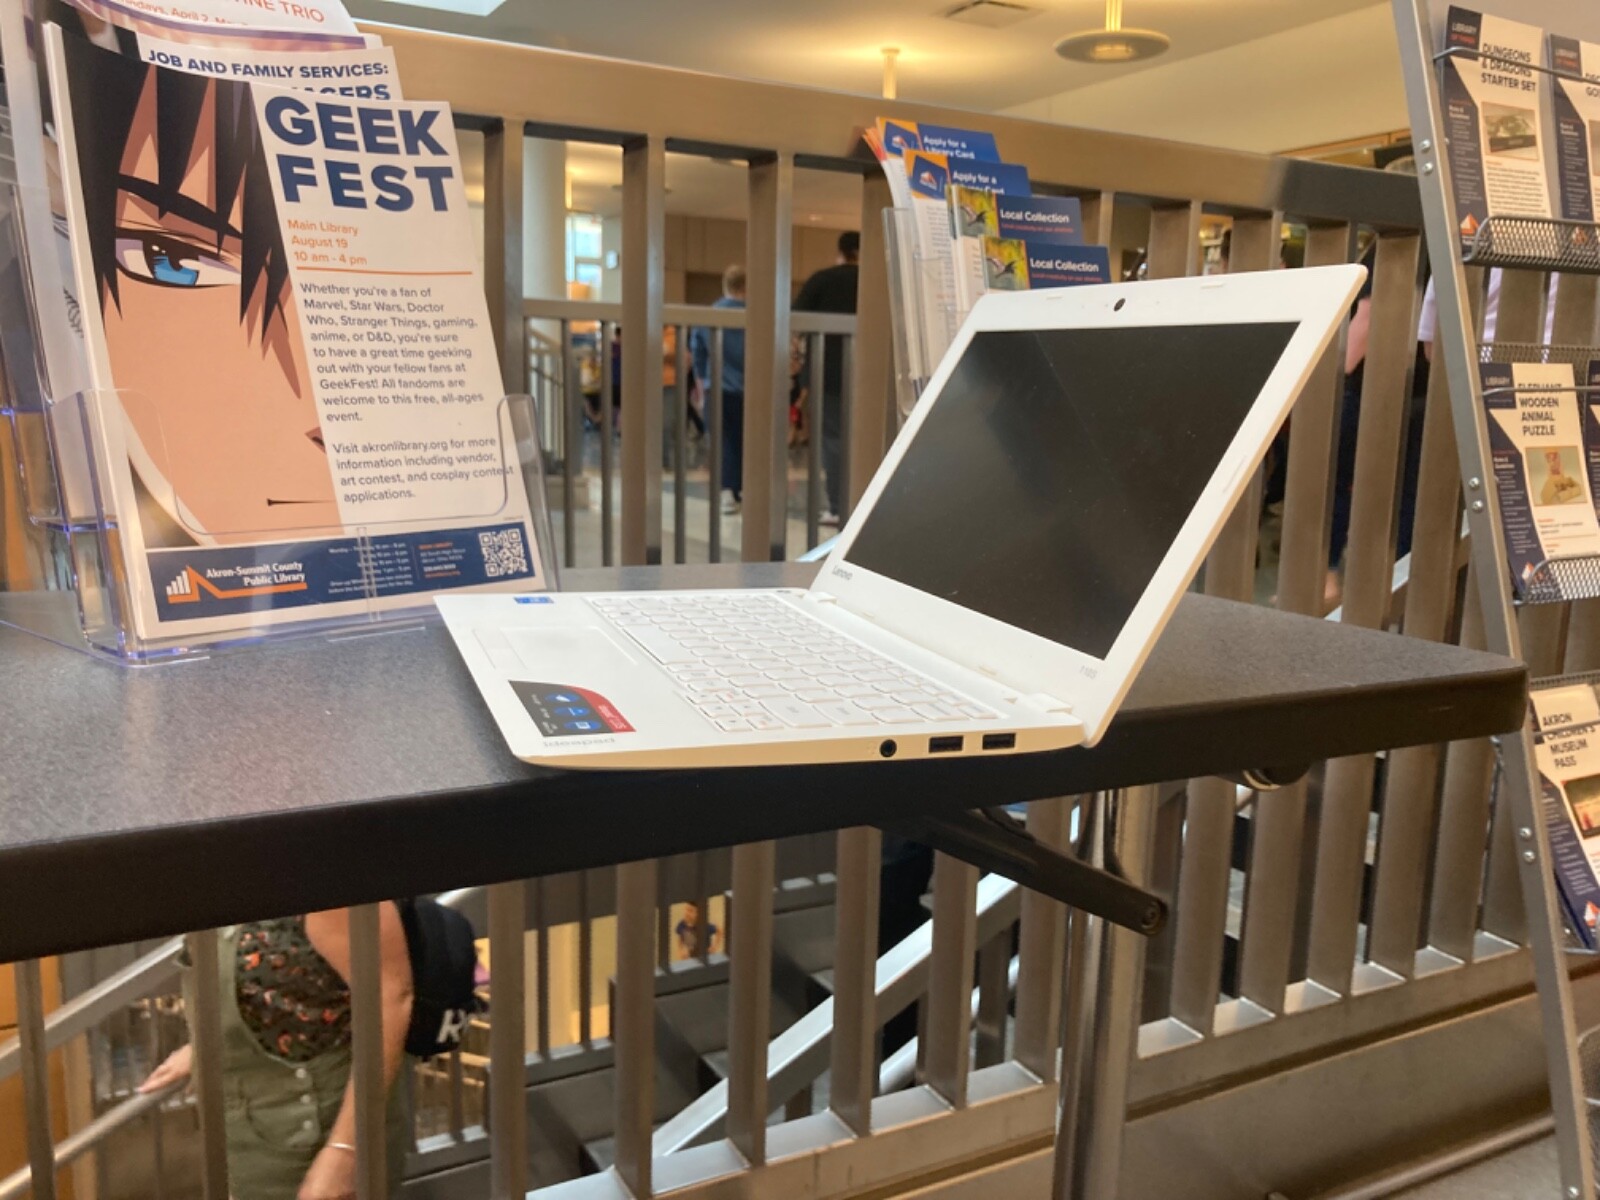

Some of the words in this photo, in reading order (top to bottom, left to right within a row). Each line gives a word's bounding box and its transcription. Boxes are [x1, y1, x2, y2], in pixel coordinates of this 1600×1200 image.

[279, 1, 325, 23] TRIO
[1483, 43, 1531, 62] DUNGEONS
[149, 49, 183, 67] JOB
[187, 58, 227, 75] AND
[232, 63, 294, 78] FAMILY
[299, 62, 390, 79] SERVICES:
[1489, 59, 1532, 77] DRAGONS
[1481, 72, 1519, 90] STARTER
[1520, 80, 1536, 92] SET
[264, 95, 450, 157] GEEK
[923, 134, 947, 148] Apply
[947, 138, 959, 148] for
[955, 149, 975, 160] Card
[275, 153, 454, 213] FEST
[952, 170, 977, 184] Apply
[977, 173, 989, 183] for
[1000, 208, 1023, 221] Local
[1024, 211, 1070, 224] Collection
[287, 219, 317, 230] Main
[320, 221, 359, 236] Library
[291, 235, 332, 248] August
[335, 237, 349, 249] 19
[294, 251, 308, 262] 10
[312, 253, 328, 263] am
[338, 254, 347, 264] 4
[350, 255, 367, 266] pm
[1029, 258, 1053, 270] Local
[1055, 259, 1100, 273] Collection
[300, 283, 350, 294] Whether
[353, 286, 388, 297] you're
[390, 289, 397, 297] a
[399, 287, 417, 297] fan
[420, 287, 431, 297] of
[304, 299, 347, 310] Marvel,
[350, 300, 371, 310] Star
[374, 301, 405, 312] Wars,
[407, 302, 444, 312] Doctor
[307, 315, 338, 326] Who,
[340, 316, 388, 328] Stranger
[390, 317, 431, 328] Things,
[310, 331, 350, 342] anime,
[352, 333, 363, 341] or
[367, 332, 396, 343] D&D,
[398, 333, 431, 345] you're
[434, 334, 458, 342] sure
[313, 347, 326, 357] to
[328, 347, 357, 357] have
[370, 348, 399, 360] great
[401, 347, 425, 357] time
[427, 347, 472, 360] geeking
[317, 364, 336, 373] out
[339, 363, 364, 373] with
[366, 365, 391, 375] your
[394, 363, 426, 373] fellow
[429, 362, 452, 373] fans
[455, 363, 466, 372] at
[320, 378, 379, 390] GeekFest!
[381, 378, 396, 389] All
[398, 377, 445, 389] fandoms
[447, 379, 465, 387] are
[323, 394, 375, 406] welcome
[378, 395, 390, 404] to
[392, 394, 412, 404] this
[414, 393, 439, 405] free,
[441, 391, 484, 404] all-ages
[1519, 397, 1559, 407] WOODEN
[326, 411, 362, 422] event.
[1521, 411, 1555, 421] ANIMAL
[1522, 425, 1555, 436] PUZZLE
[332, 442, 359, 454] Visit
[361, 439, 449, 453] akronlibrary.org
[450, 438, 465, 448] for
[468, 437, 496, 447] more
[336, 457, 402, 470] information
[404, 454, 453, 467] including
[455, 452, 497, 464] vendor,
[340, 476, 356, 486] art
[358, 473, 405, 486] contest,
[407, 470, 428, 482] and
[430, 468, 470, 481] cosplay
[344, 489, 416, 504] applications.
[205, 564, 271, 579] Akron-Summit
[272, 561, 303, 574] County
[242, 575, 273, 587] Public
[274, 572, 305, 584] Library
[1543, 713, 1573, 727] AKRON
[1550, 738, 1588, 755] MUSEUM
[1554, 755, 1577, 769] PASS
